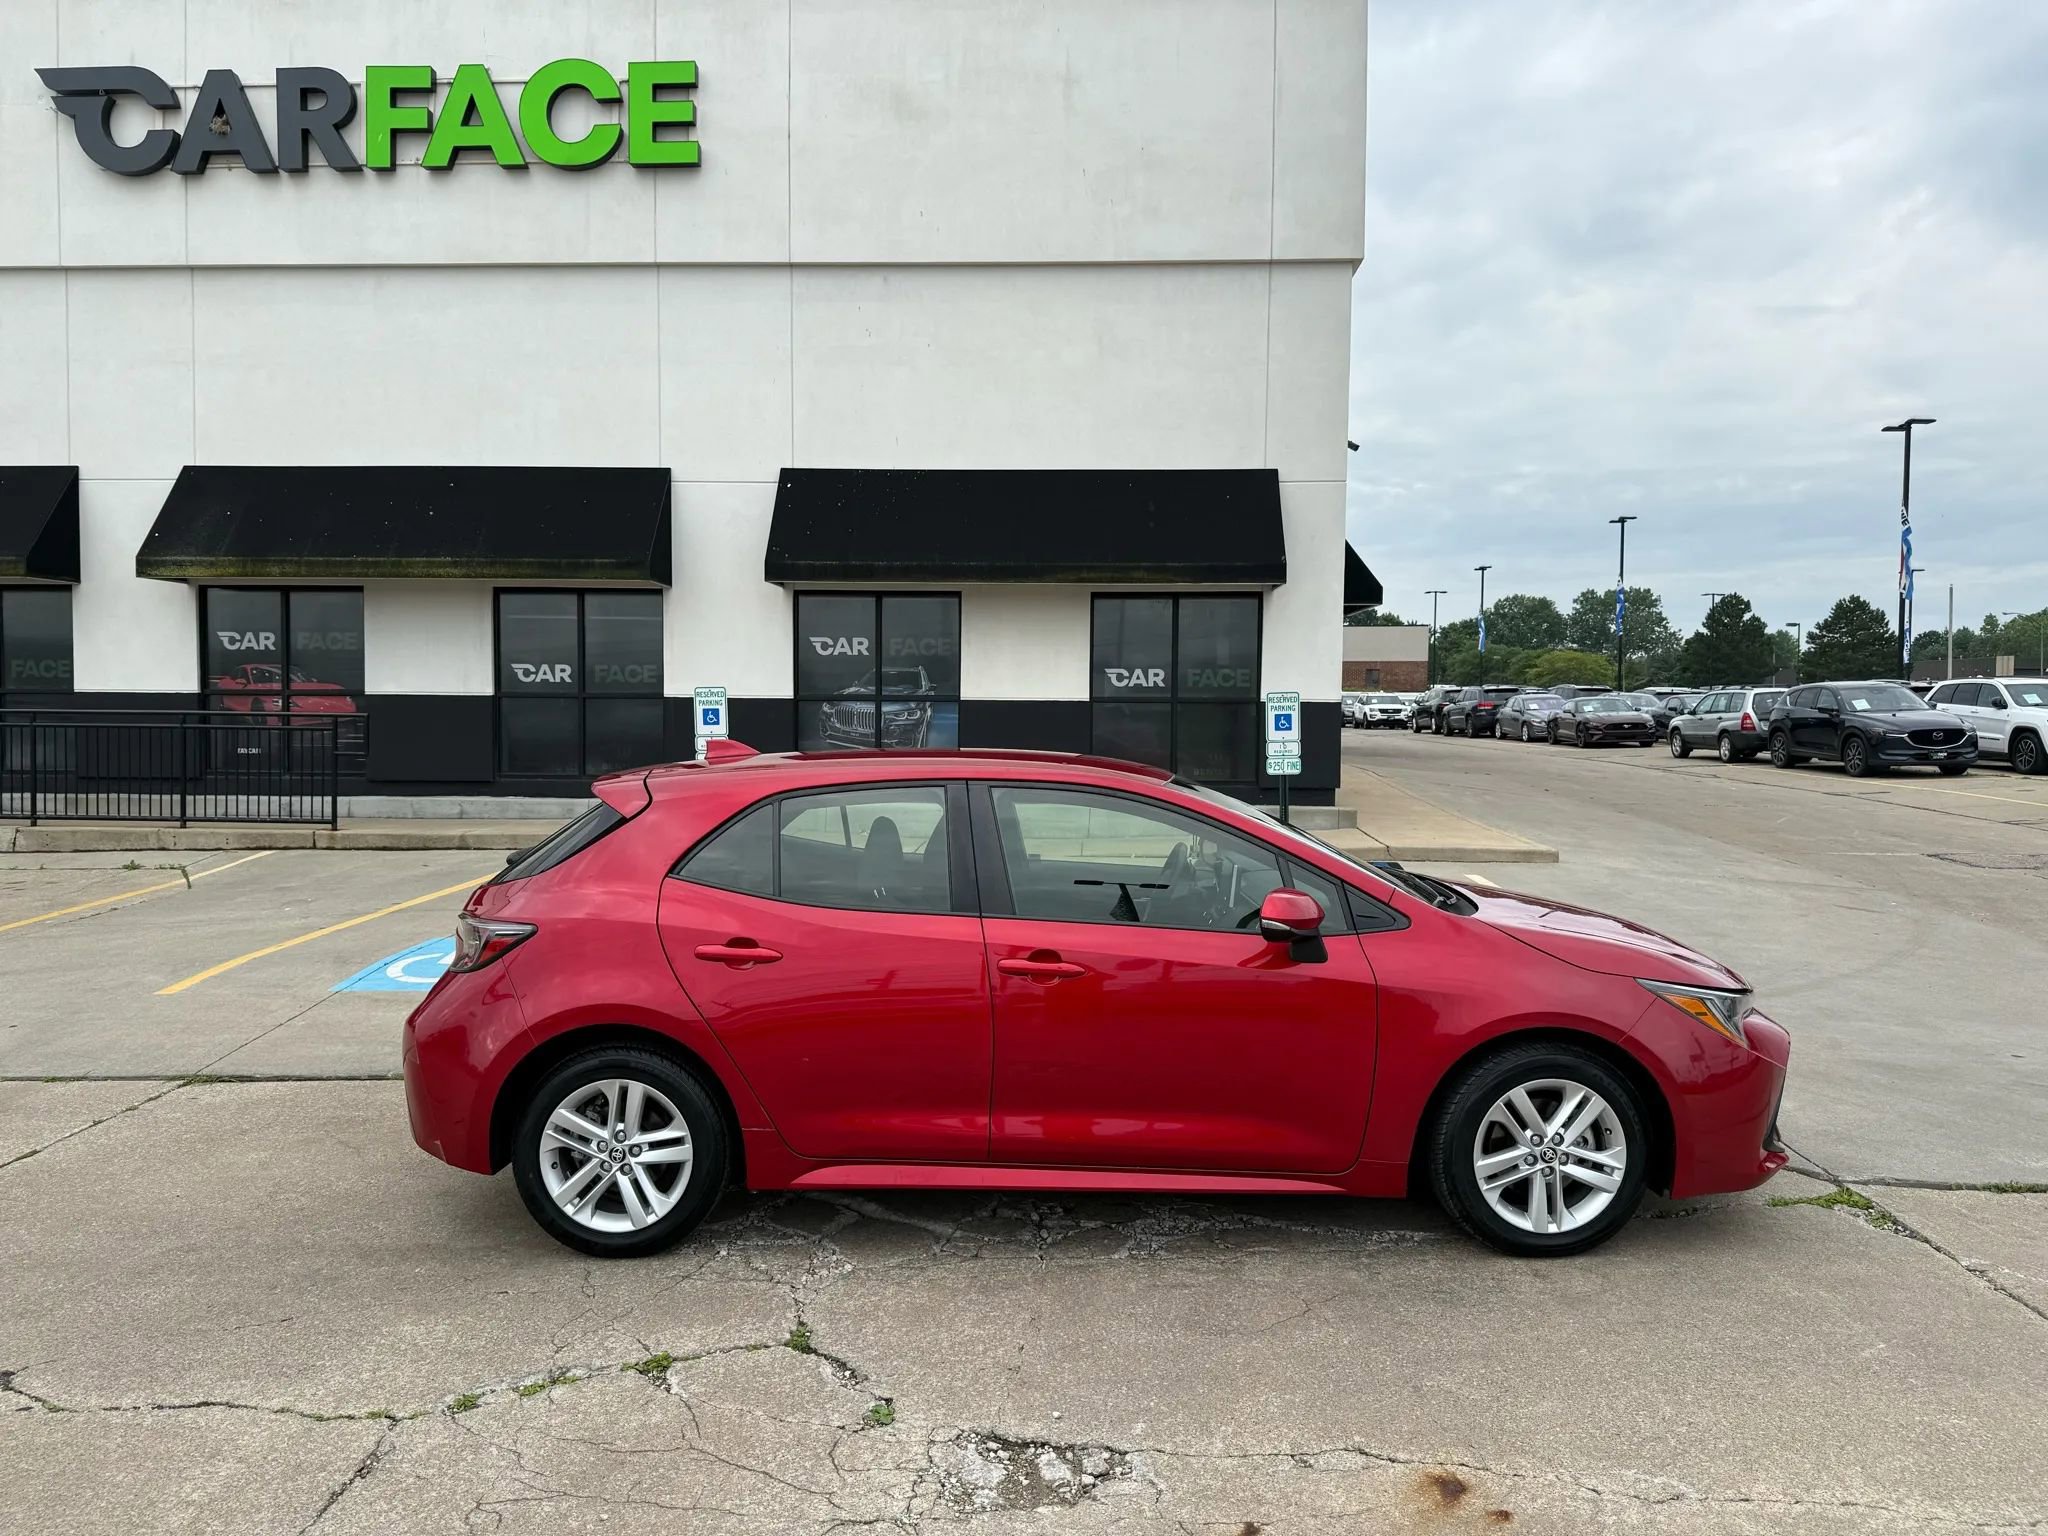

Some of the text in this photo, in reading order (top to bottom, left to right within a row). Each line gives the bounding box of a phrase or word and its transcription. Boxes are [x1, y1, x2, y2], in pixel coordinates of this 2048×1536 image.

[34, 58, 702, 176] CARFACE
[216, 631, 359, 650] CAR FACE
[809, 636, 952, 656] CAR FACE
[10, 659, 71, 678] FACE
[510, 663, 657, 683] CAR FACE
[1104, 668, 1251, 688] CAR FACE
[696, 690, 725, 698] RESERVED
[698, 699, 723, 707] PARKING
[1268, 696, 1298, 704] RESERVED
[1270, 704, 1296, 712] PARKING
[1268, 761, 1300, 771] $250 FINE
